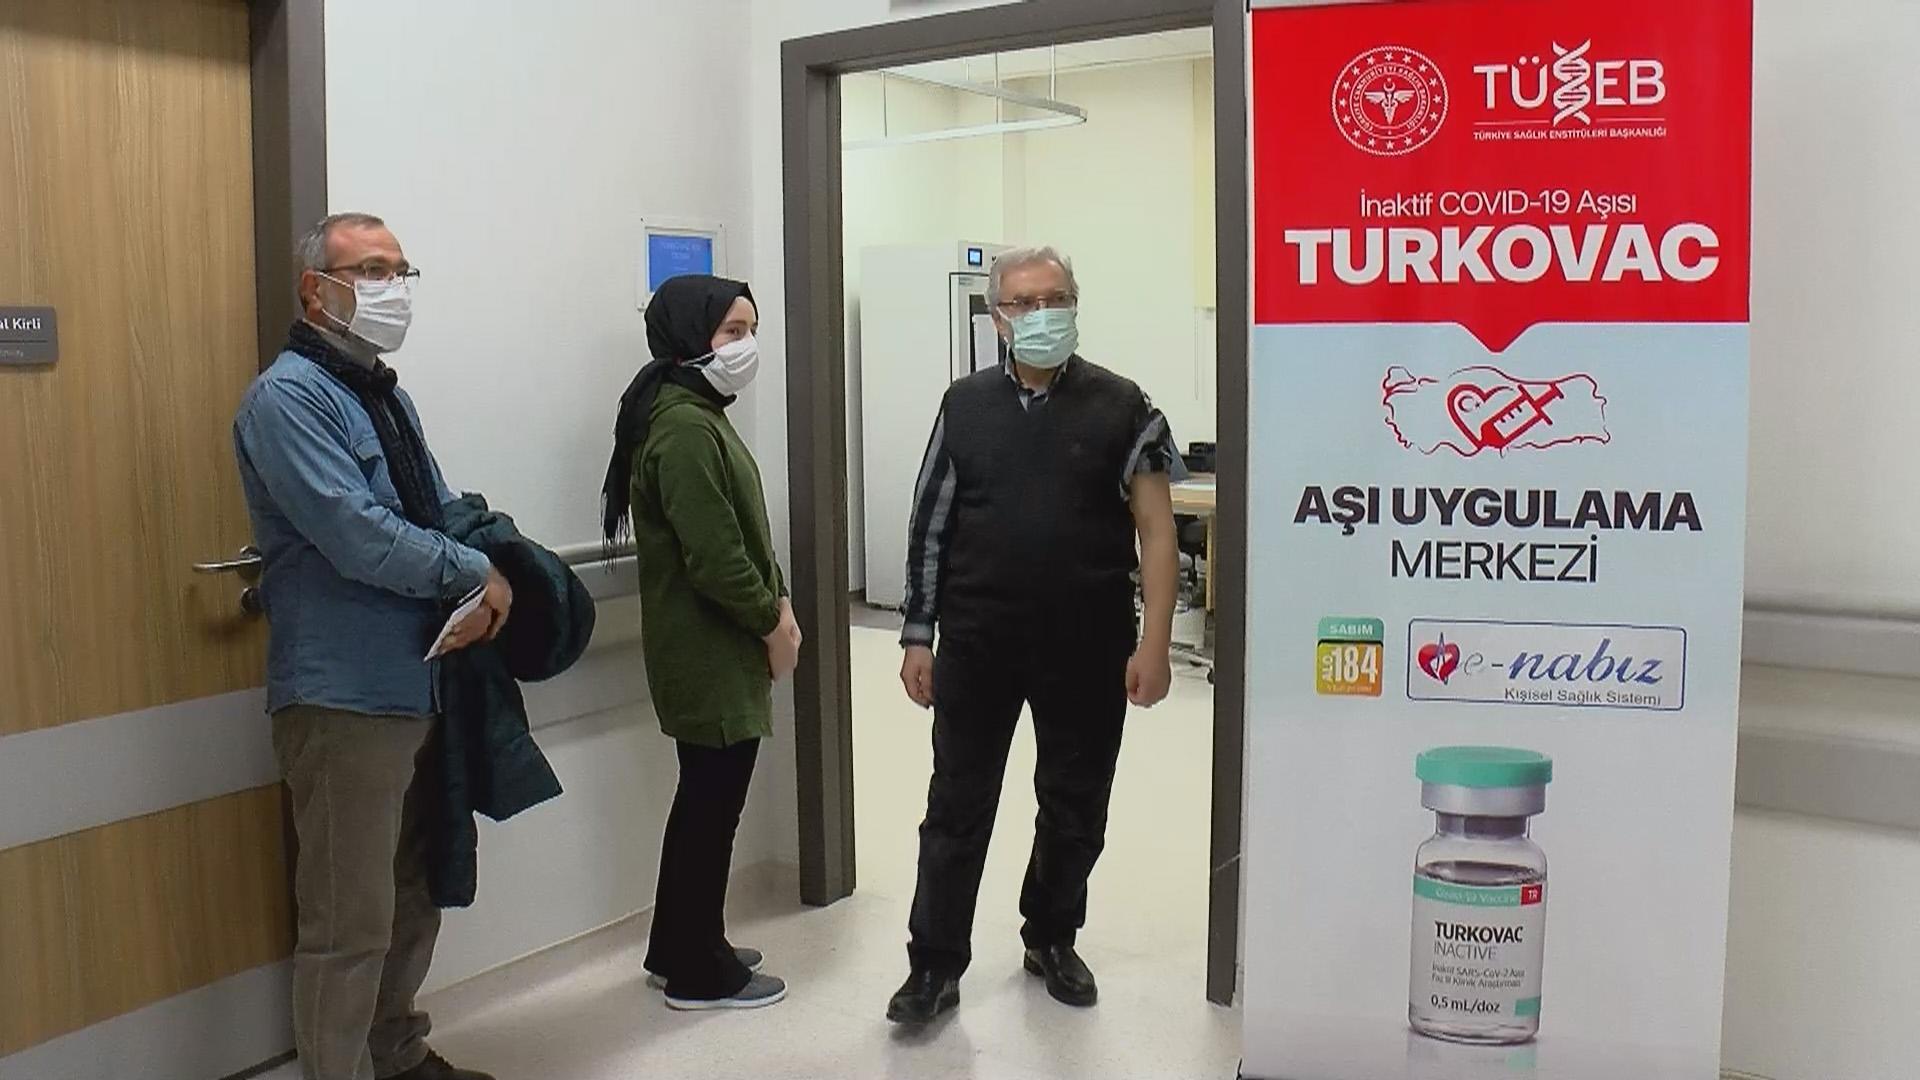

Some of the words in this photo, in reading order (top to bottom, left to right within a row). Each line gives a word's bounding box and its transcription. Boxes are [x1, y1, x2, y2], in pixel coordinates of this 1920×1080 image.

[1473, 131, 1511, 140] TÜRKİYE
[1513, 129, 1546, 140] SAĞLIK
[1549, 127, 1607, 139] ENSTİTÜLERİ
[1609, 126, 1666, 139] BAŞKANLIĞI
[1360, 189, 1433, 217] İnaktif
[1439, 189, 1570, 216] COVID-19
[1576, 190, 1637, 219] Aşısı
[1284, 222, 1720, 285] TURKOVAC
[13, 317, 41, 330] Kirli
[1294, 486, 1379, 535] AŞI
[1392, 488, 1702, 531] UYGULAMA
[1391, 534, 1598, 583] MERKEZİ
[1332, 645, 1379, 684] 184
[1504, 687, 1553, 702] Kişisel
[1557, 690, 1601, 704] Sağlık
[1606, 693, 1661, 706] Sistemi
[1528, 889, 1539, 900] TR
[1434, 920, 1523, 943] TURKOVAC
[1434, 942, 1497, 960] INACTIVE
[1451, 997, 1501, 1014] mL/doz
